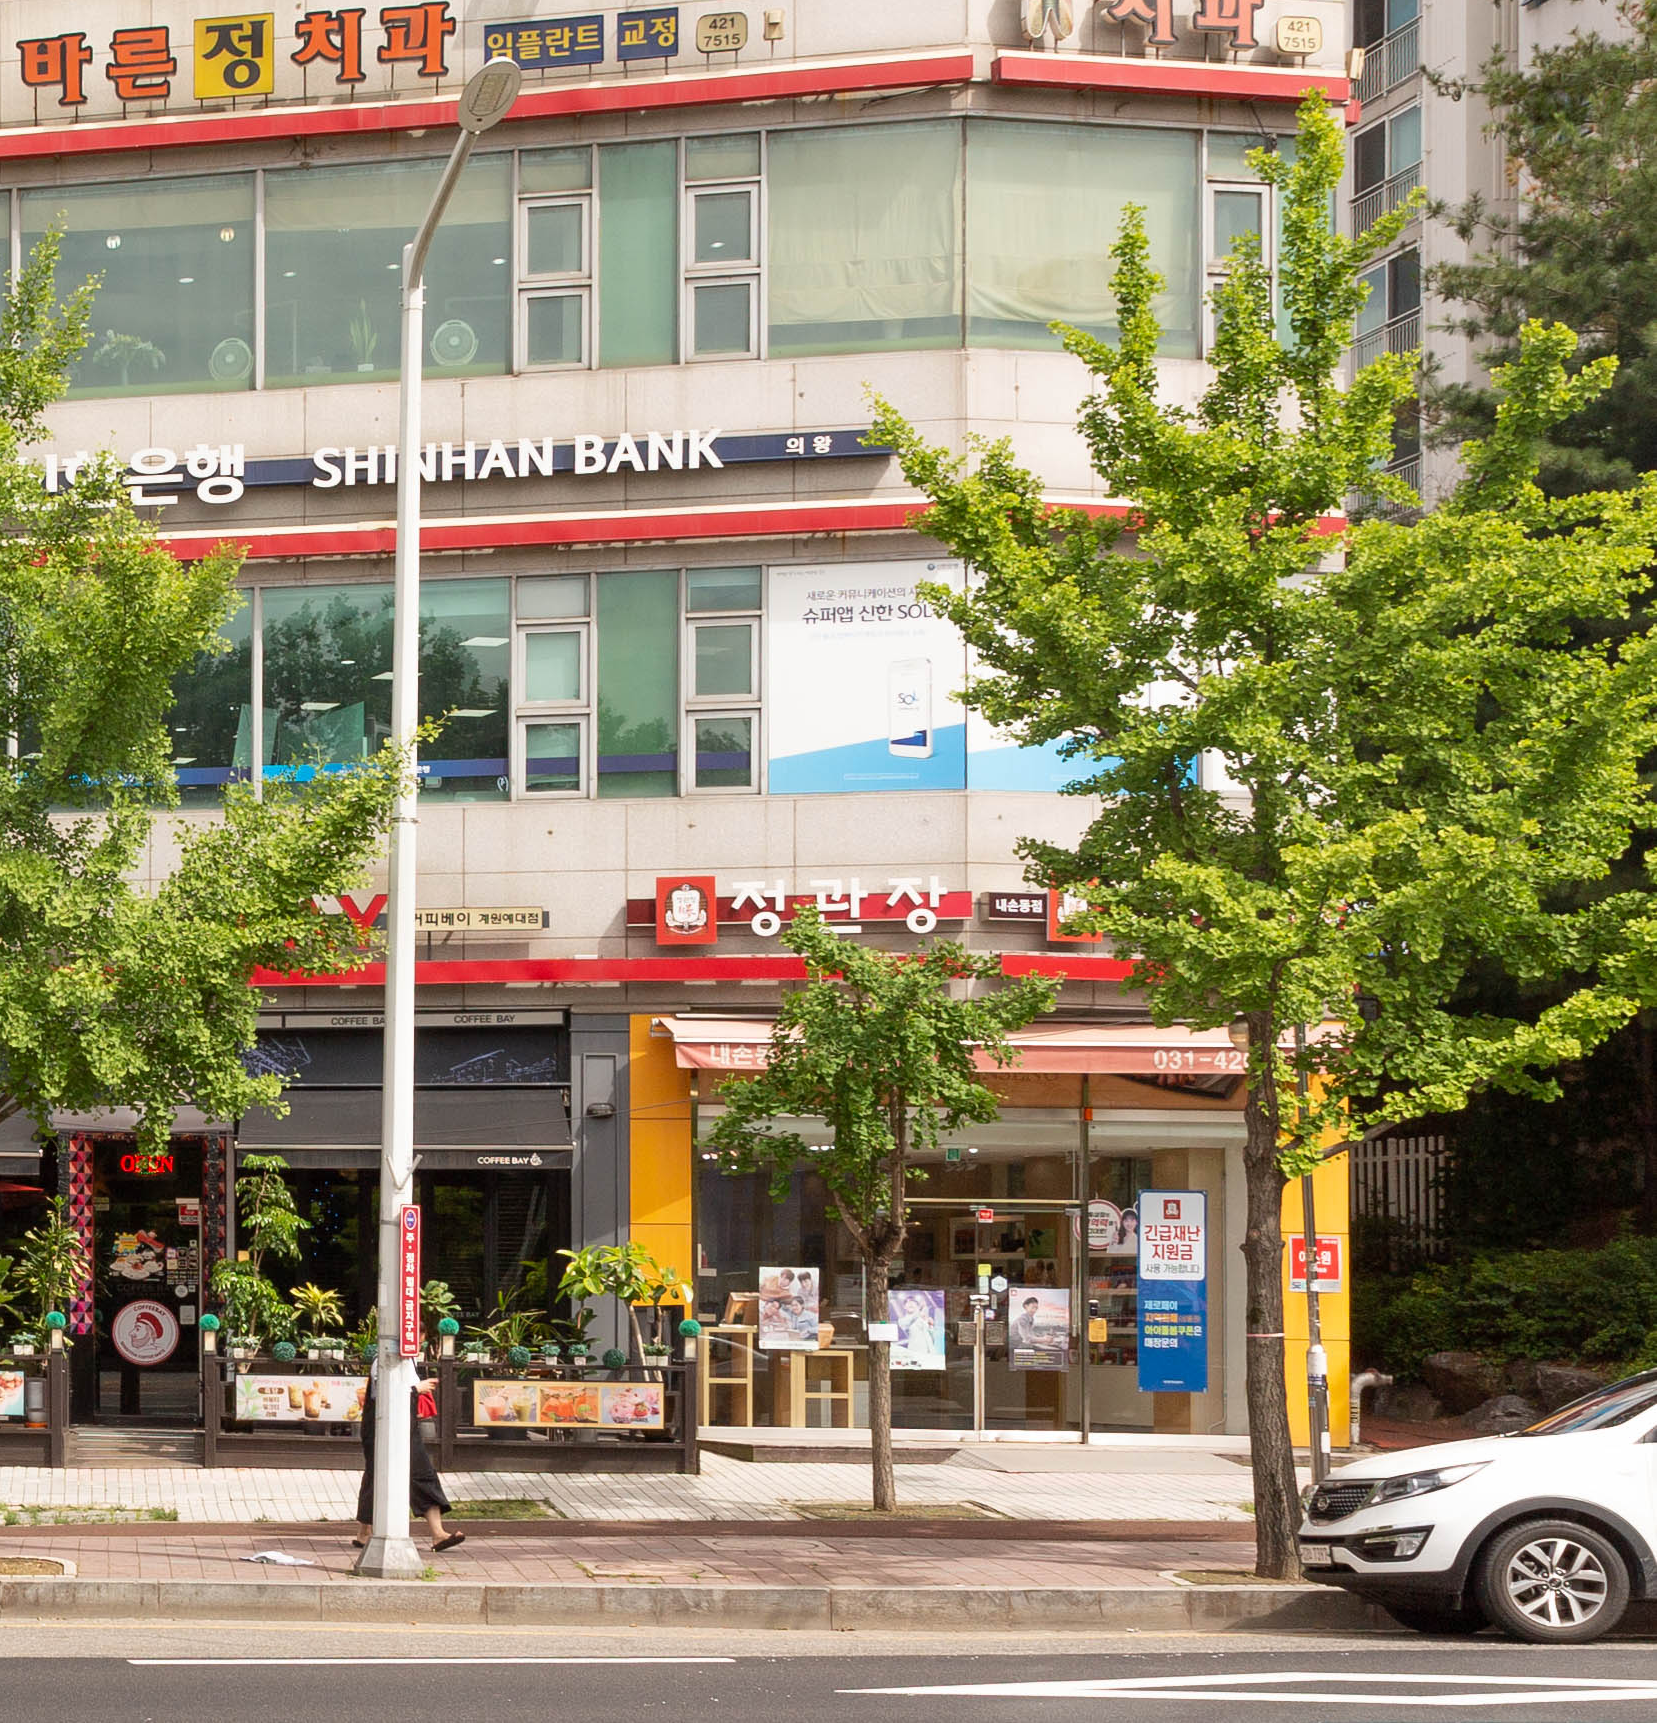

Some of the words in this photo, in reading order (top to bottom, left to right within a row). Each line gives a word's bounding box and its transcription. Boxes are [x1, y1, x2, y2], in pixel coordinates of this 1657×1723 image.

[708, 16, 736, 29] 421
[1287, 21, 1310, 33] 421
[621, 17, 677, 46] 교정
[703, 33, 741, 46] 7515
[487, 25, 603, 62] 임플란트
[1283, 36, 1317, 49] 7515
[785, 435, 834, 455] 의왕
[312, 435, 554, 488] SHINHAN
[574, 428, 725, 475] BANK
[802, 606, 854, 625] 슈퍼앱
[859, 603, 894, 623] 신한
[897, 602, 932, 620] SOL
[730, 874, 949, 938] 정관장
[994, 898, 1043, 915] 내손동점
[478, 911, 540, 926] 계원예대점
[331, 1016, 368, 1026] COFFEE
[454, 1014, 490, 1024] COFFEE
[496, 1013, 516, 1023] BAY
[477, 1156, 511, 1165] COFFEE
[511, 1156, 529, 1165] BAY
[1143, 1224, 1201, 1243] 긴급재난
[1151, 1243, 1194, 1261] 지원금
[1144, 1263, 1162, 1275] 사용
[1162, 1263, 1200, 1275] 가능합니다
